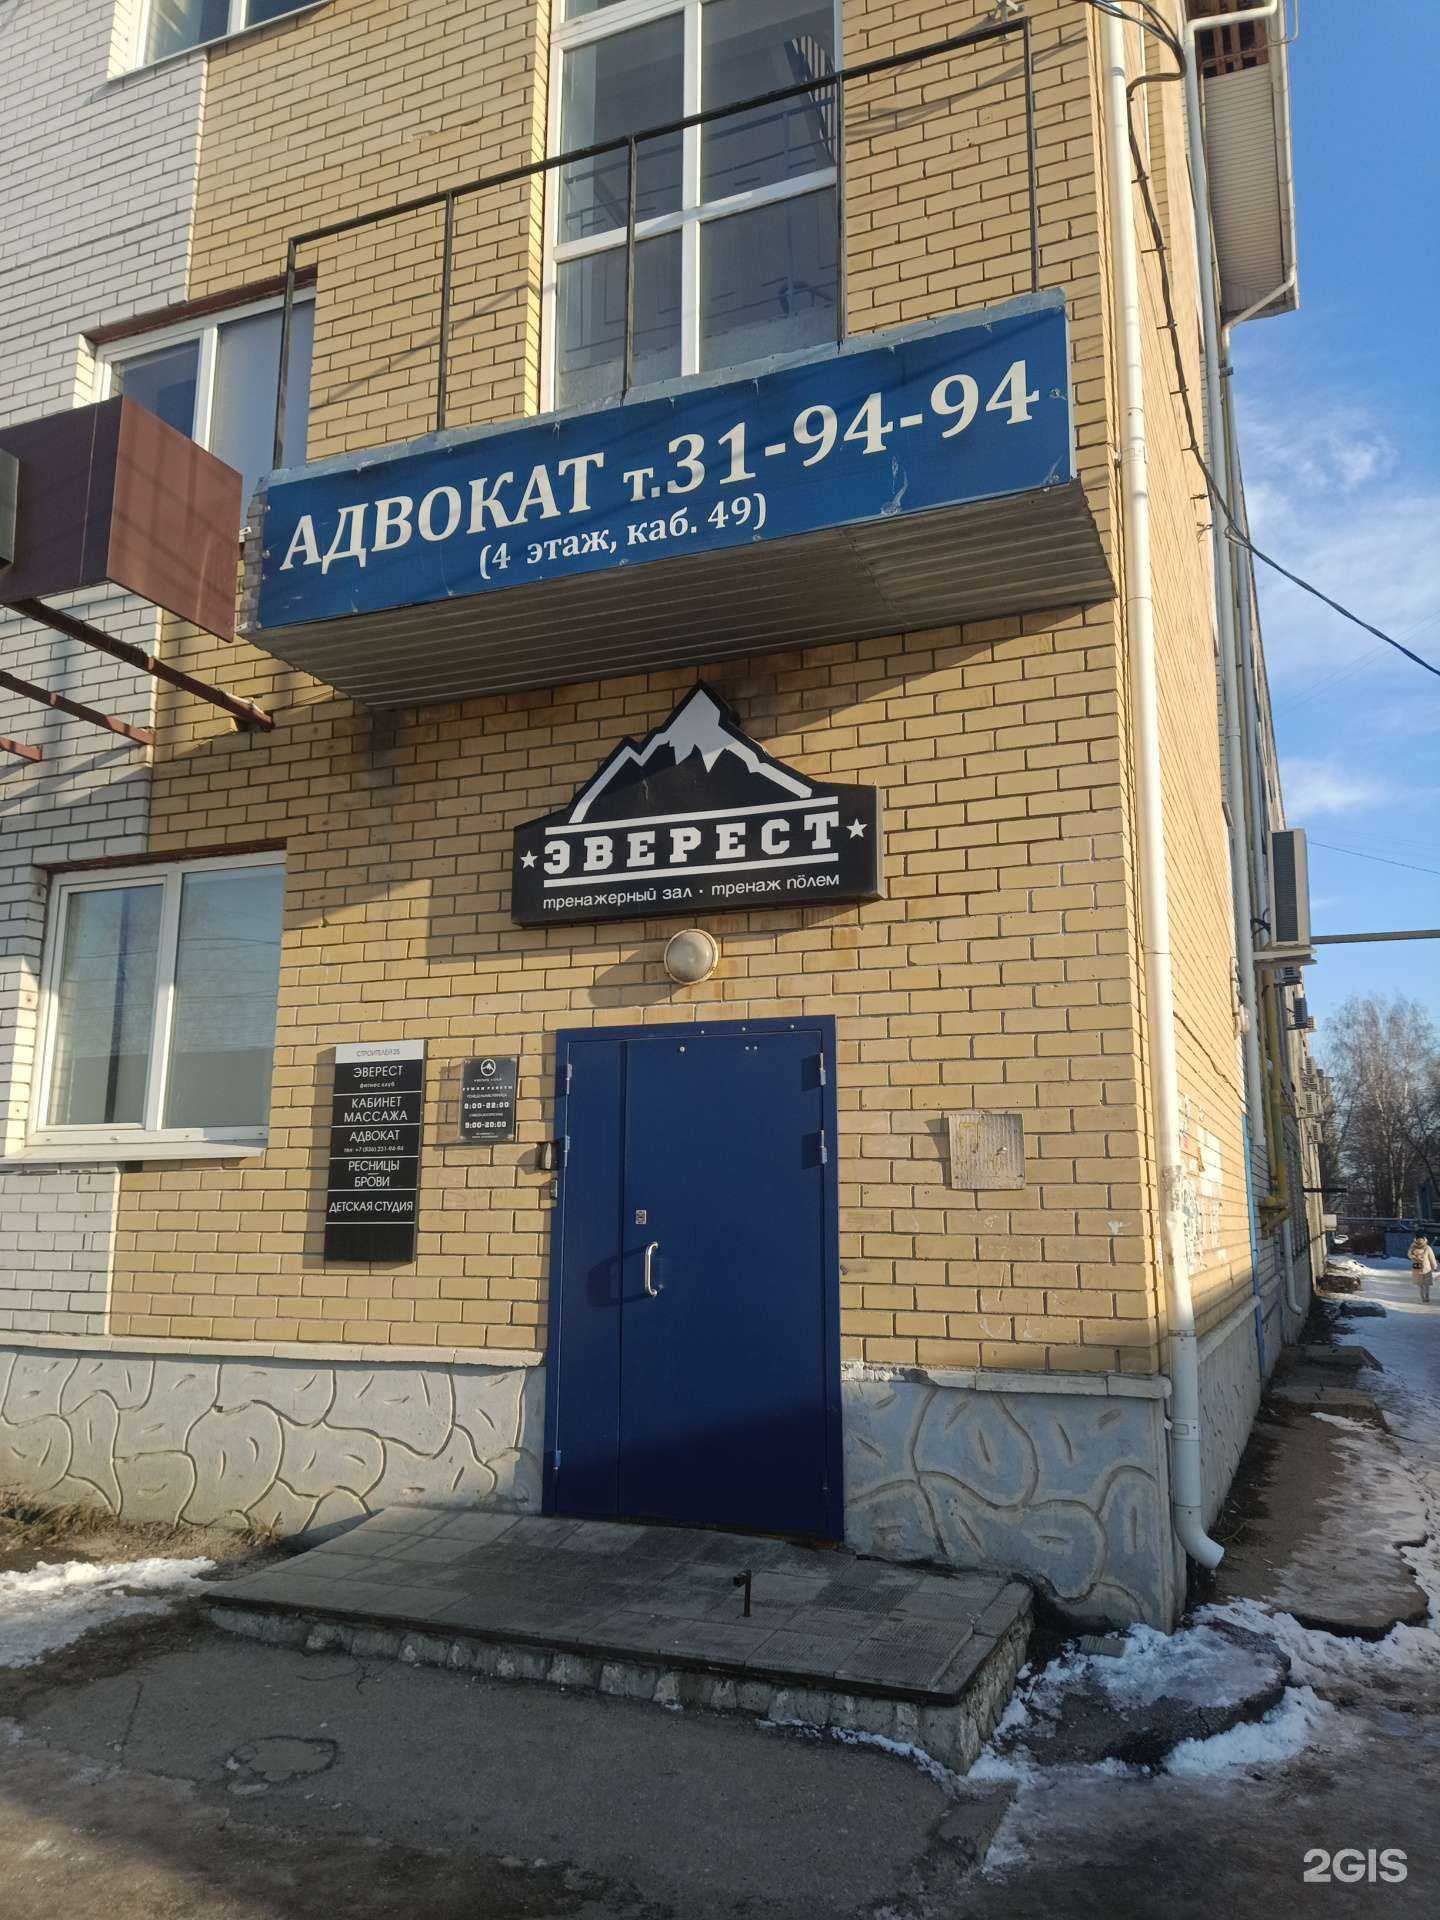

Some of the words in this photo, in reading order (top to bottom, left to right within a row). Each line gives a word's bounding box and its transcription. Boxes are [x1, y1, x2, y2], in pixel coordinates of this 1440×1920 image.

[279, 450, 605, 576] АДВОКАТ
[622, 360, 1041, 504] т.31-94-94
[478, 541, 512, 581] (4
[526, 525, 618, 563] этаж,
[626, 512, 698, 547] каб.
[707, 492, 769, 532] 49)
[543, 811, 840, 876] ЭВЕРЕСТ
[543, 887, 657, 912] тренажерный
[662, 886, 693, 901] зал
[711, 878, 782, 898] тренаж
[353, 1065, 404, 1078] ЭВЕРЕСТ
[351, 1096, 402, 1109] КАБИНЕТ
[344, 1110, 408, 1123] МАССАЖА
[349, 1129, 401, 1143] АДВОКАТ
[348, 1159, 400, 1173] РЕСНИЦЫ
[354, 1176, 390, 1188] БРОВИ
[329, 1200, 373, 1213] ДЕТСКАЯ
[374, 1200, 413, 1213] СТУДИЯ
